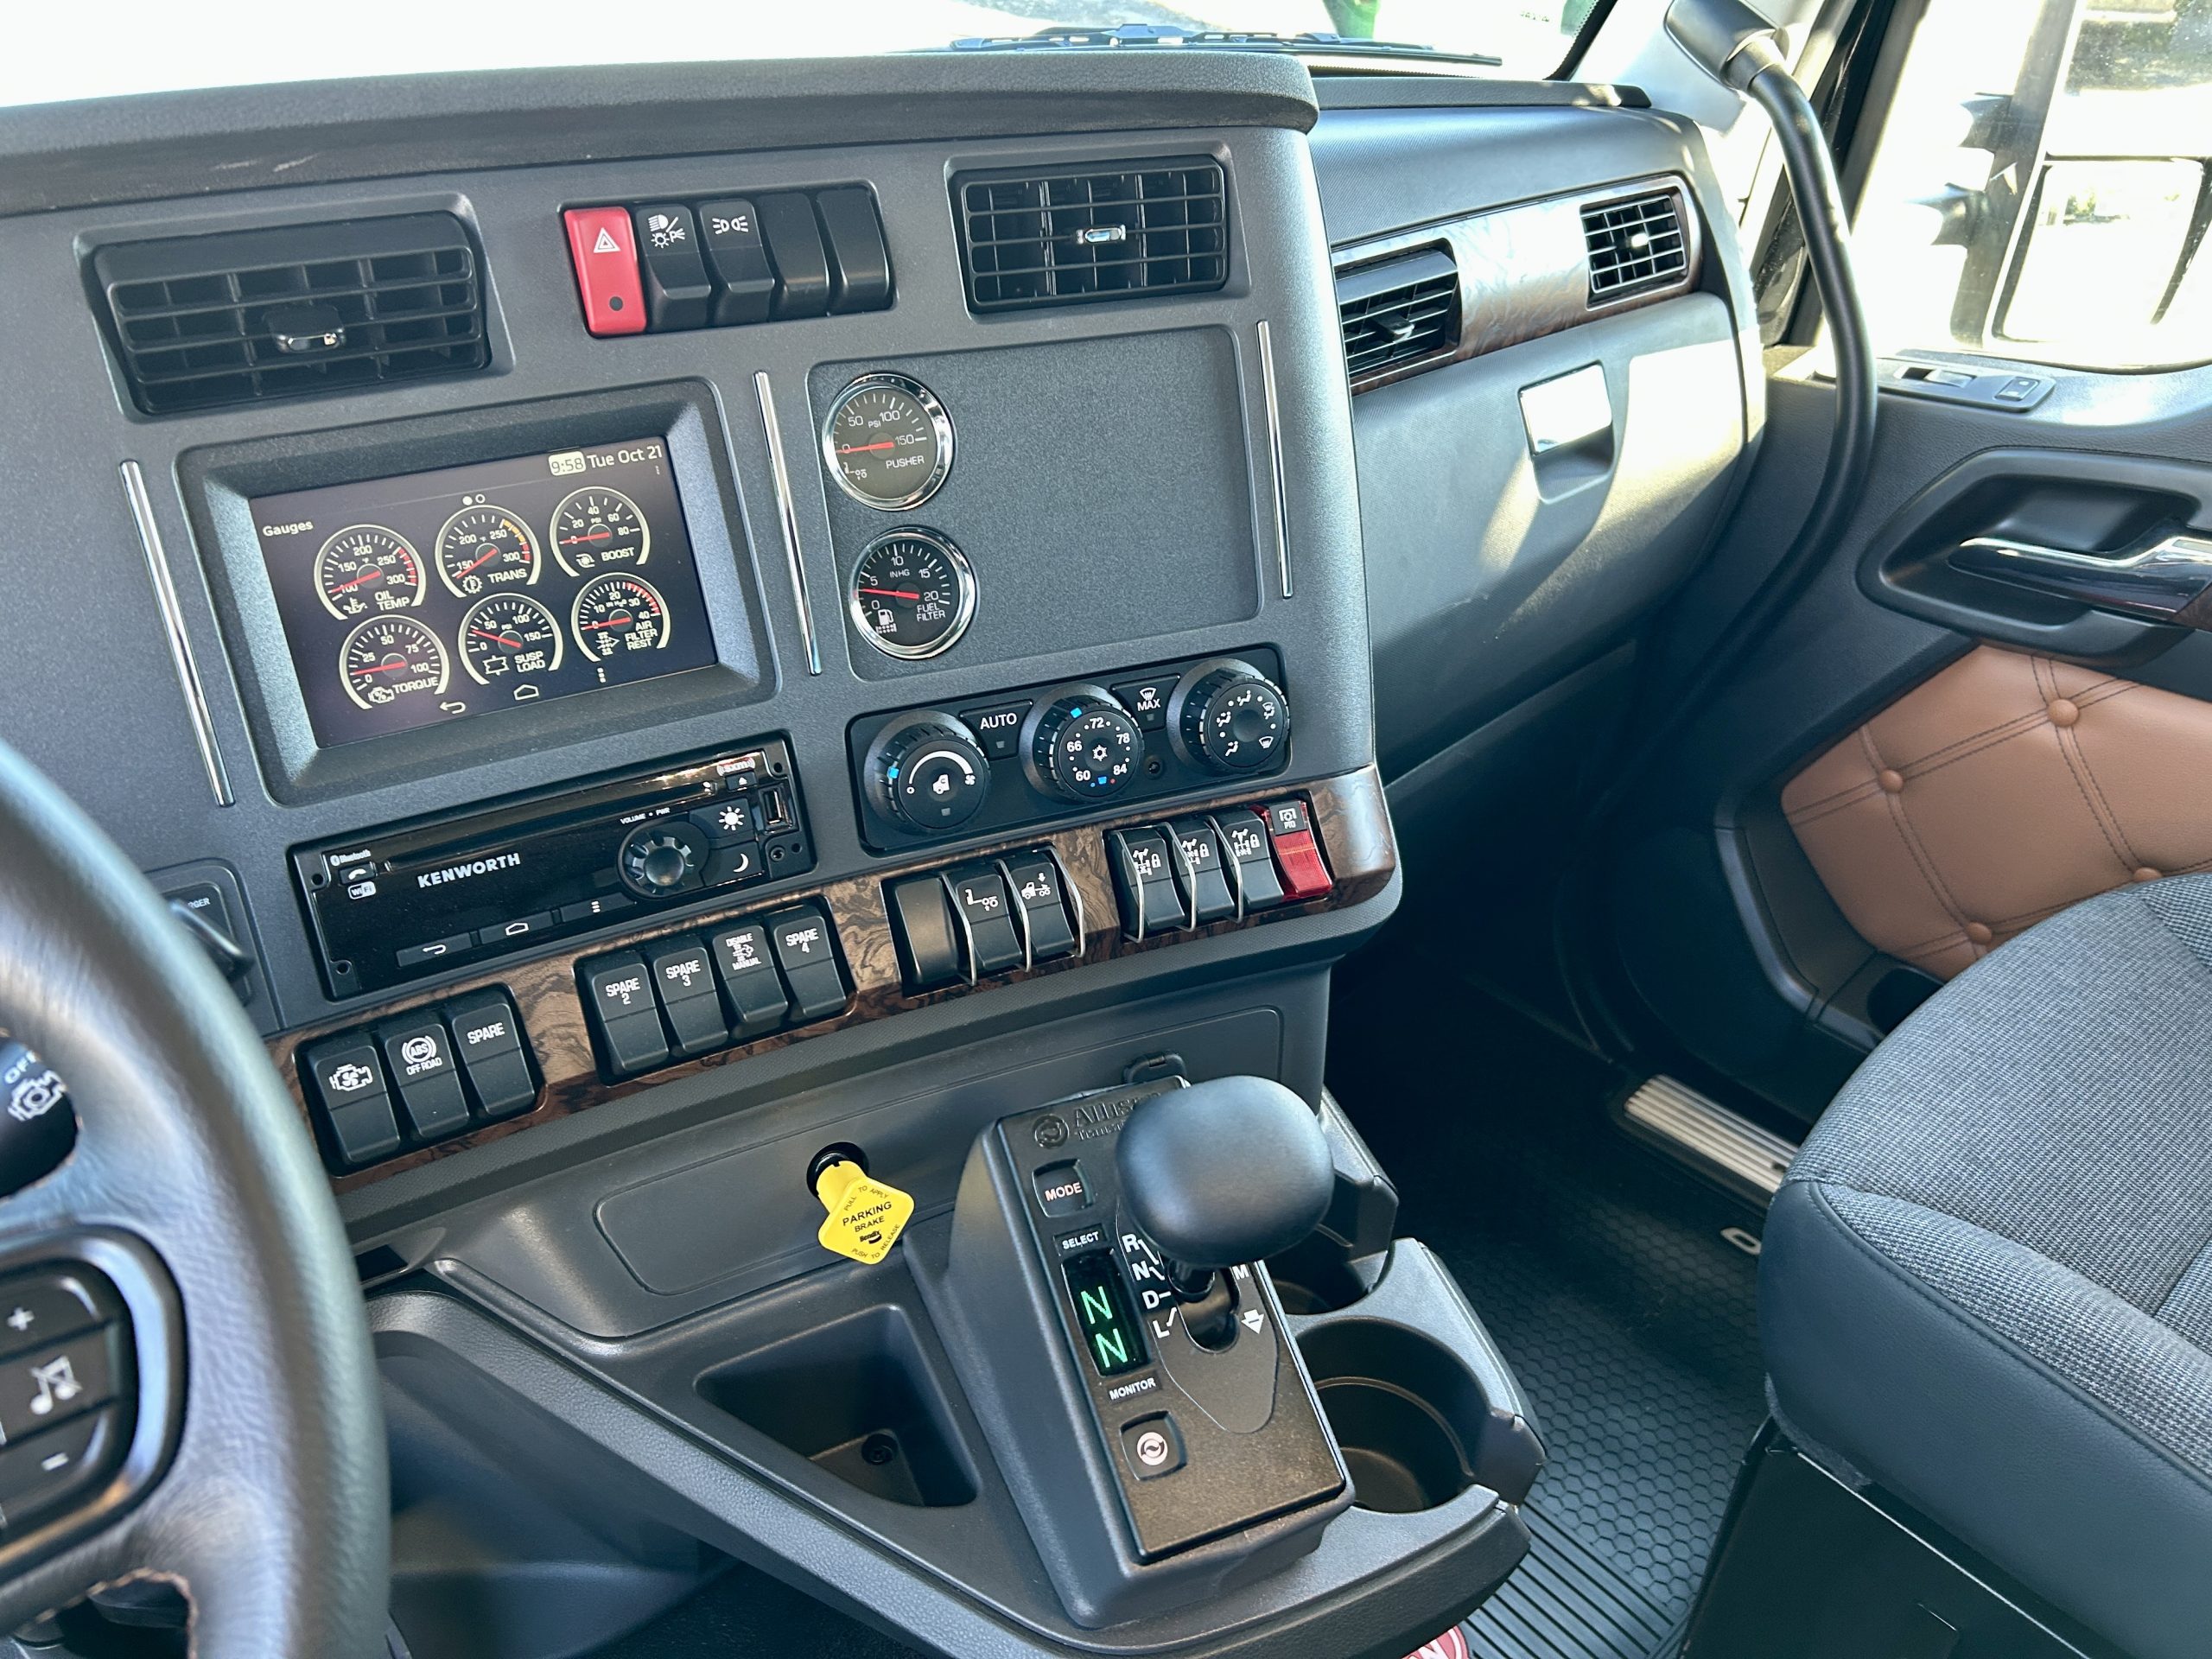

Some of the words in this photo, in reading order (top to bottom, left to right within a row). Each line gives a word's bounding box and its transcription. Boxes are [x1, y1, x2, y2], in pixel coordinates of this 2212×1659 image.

[848, 416, 863, 427] 50
[880, 410, 900, 422] 100
[895, 434, 914, 446] 150
[842, 444, 850, 454] 0
[551, 457, 584, 474] 9:58
[587, 454, 615, 468] Tue
[618, 448, 645, 463] Oct
[647, 445, 662, 460] 21
[886, 455, 925, 468] PUSHER
[588, 506, 600, 515] 40
[607, 512, 620, 522] 60
[263, 521, 313, 536] Gauges
[572, 519, 584, 529] 20
[489, 529, 507, 539] 250
[617, 526, 629, 536] 80
[459, 534, 477, 544] 200
[353, 544, 372, 556] 200
[601, 547, 634, 562] BOOST
[377, 555, 396, 566] 250
[503, 552, 520, 563] 300
[890, 556, 904, 566] 10
[338, 562, 356, 572] 150
[456, 560, 474, 570] 150
[386, 574, 405, 585] 300
[487, 569, 527, 583] TRANS
[918, 569, 931, 578] 15
[870, 575, 878, 586] 5
[375, 591, 394, 601] OIL
[608, 591, 620, 600] 20
[924, 591, 939, 601] 20
[377, 596, 410, 611] TEMP
[594, 604, 605, 613] 10
[629, 598, 640, 607] 30
[871, 600, 880, 610] 0
[917, 603, 940, 613] FUEL
[512, 614, 530, 624] 100
[639, 611, 650, 620] 40
[916, 610, 945, 622] FILTER
[484, 620, 497, 630] 50
[636, 620, 653, 631] AIR
[380, 634, 394, 645] 50
[524, 632, 541, 641] 150
[624, 629, 658, 641] FILTER
[404, 644, 419, 654] 75
[479, 641, 487, 650] 0
[626, 639, 652, 650] REST
[362, 652, 375, 663] 25
[514, 651, 543, 664] SUSP
[410, 663, 429, 673] 100
[517, 660, 546, 672] LOAD
[365, 674, 373, 683] 0
[392, 677, 439, 693] TORQUE
[1137, 698, 1161, 712] MAX
[980, 713, 1018, 729] AUTO
[1089, 717, 1104, 729] 72
[1116, 733, 1130, 745] 78
[1066, 741, 1082, 752] 66
[1075, 770, 1090, 781] 60
[1113, 764, 1127, 776] 84
[620, 813, 646, 824] VOLUME
[655, 807, 671, 816] PWR
[339, 849, 372, 863] Bluetooth
[417, 852, 520, 888] KENWORTH
[726, 933, 753, 947] DISABLE
[785, 928, 819, 947] SPARE
[801, 942, 810, 953] 4
[665, 959, 700, 980] SPARE
[732, 957, 762, 970] MANUAL
[605, 977, 641, 997] SPARE
[682, 975, 691, 987] 3
[621, 993, 631, 1004] 2
[467, 1022, 505, 1045] SPARE
[410, 1044, 429, 1056] ABS
[406, 1064, 423, 1075] OFF
[422, 1058, 442, 1071] ROAD
[1045, 1181, 1083, 1201] MODE
[843, 1196, 857, 1211] PULL
[869, 1189, 888, 1199] APPLY
[842, 1201, 892, 1226] PARKING
[854, 1216, 885, 1232] BRAKE
[851, 1248, 869, 1258] PUSH
[880, 1224, 900, 1251] RELEASE
[859, 1230, 880, 1243] Bendix
[1062, 1231, 1099, 1249] SELECT
[1122, 1233, 1141, 1254] R
[1131, 1261, 1150, 1281] N
[1232, 1263, 1249, 1281] M
[1080, 1286, 1113, 1324] N
[1142, 1290, 1160, 1310] D
[1153, 1319, 1171, 1339] L
[1095, 1328, 1128, 1368] N
[1109, 1377, 1156, 1400] MONITOR
